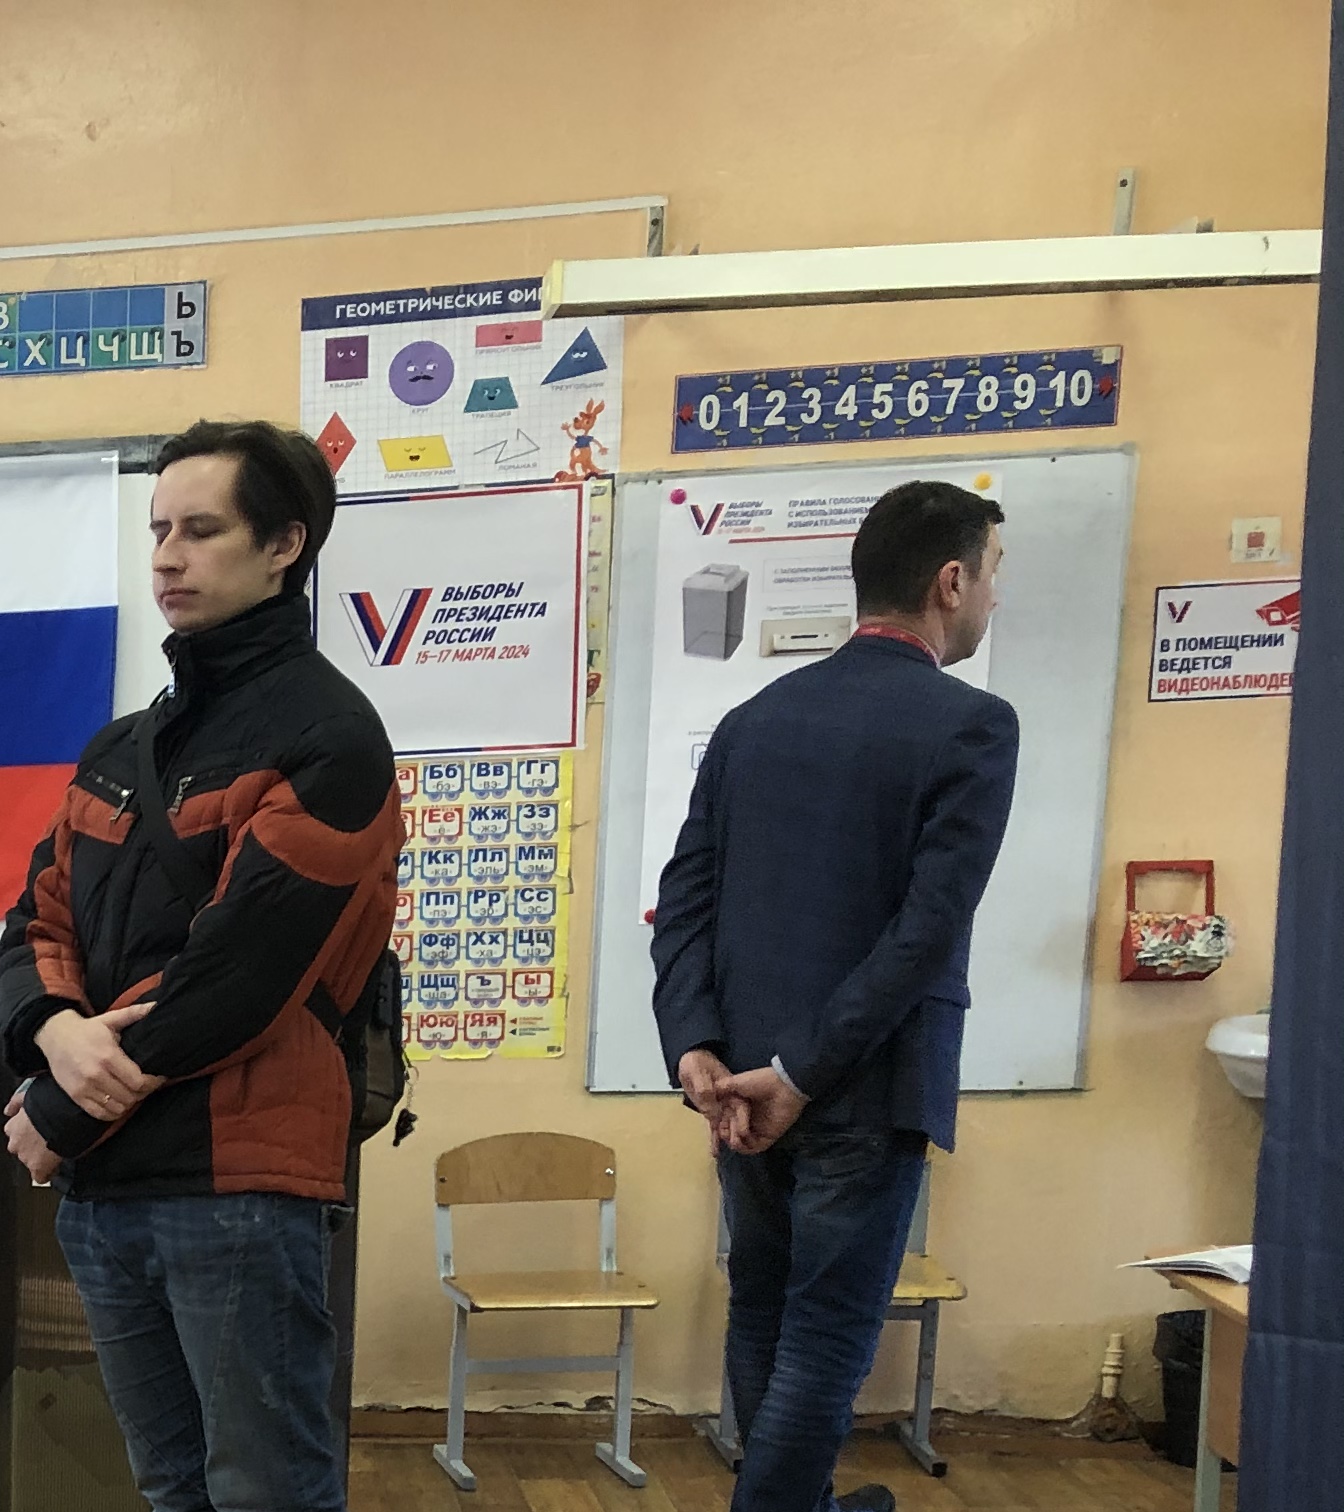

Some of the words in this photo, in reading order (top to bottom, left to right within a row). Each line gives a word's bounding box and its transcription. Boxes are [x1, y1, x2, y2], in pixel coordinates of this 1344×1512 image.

[177, 291, 196, 319] Ь
[336, 290, 503, 318] ГЕОМЕТРИЧЕСКИЕ
[508, 287, 542, 304] ФИ
[23, 338, 47, 367] Х
[60, 335, 86, 367] Ц
[98, 333, 119, 362] Ч
[130, 331, 163, 363] Щ
[171, 330, 195, 357] Ъ
[698, 394, 721, 431] 0
[733, 391, 749, 428] 1
[764, 389, 787, 426] 2
[800, 387, 822, 424] 3
[834, 384, 858, 421] 4
[871, 383, 894, 420] 5
[907, 380, 930, 418] 6
[942, 377, 965, 415] 7
[976, 375, 999, 413] 8
[1013, 373, 1036, 411] 9
[1049, 369, 1093, 408] 10
[441, 581, 525, 603] ВЫБОРЫ
[431, 602, 548, 624] ПРЕЗИДЕНТА
[422, 626, 497, 646] РОССИИ
[1159, 638, 1170, 653] В
[1175, 633, 1284, 652] ПОМЕЩЕНИИ
[453, 646, 496, 663] МАРТА
[497, 644, 530, 661] 2024
[1158, 656, 1232, 674] ВЕДЕТСЯ
[429, 763, 458, 779] Бб
[476, 762, 505, 777] Вв
[525, 760, 550, 775] Гг
[470, 806, 508, 821] Жж
[523, 804, 551, 819] Зз
[427, 850, 455, 865] Кк
[472, 848, 503, 863] Лл
[518, 846, 554, 860] Мм
[425, 891, 455, 906] Пп
[473, 889, 501, 907] Рр
[519, 888, 550, 902] Сс
[423, 933, 456, 949] Фф
[471, 931, 500, 945] Хх
[420, 974, 457, 991] Щщ
[420, 1014, 456, 1028] Юю
[469, 1013, 498, 1027] Яя
